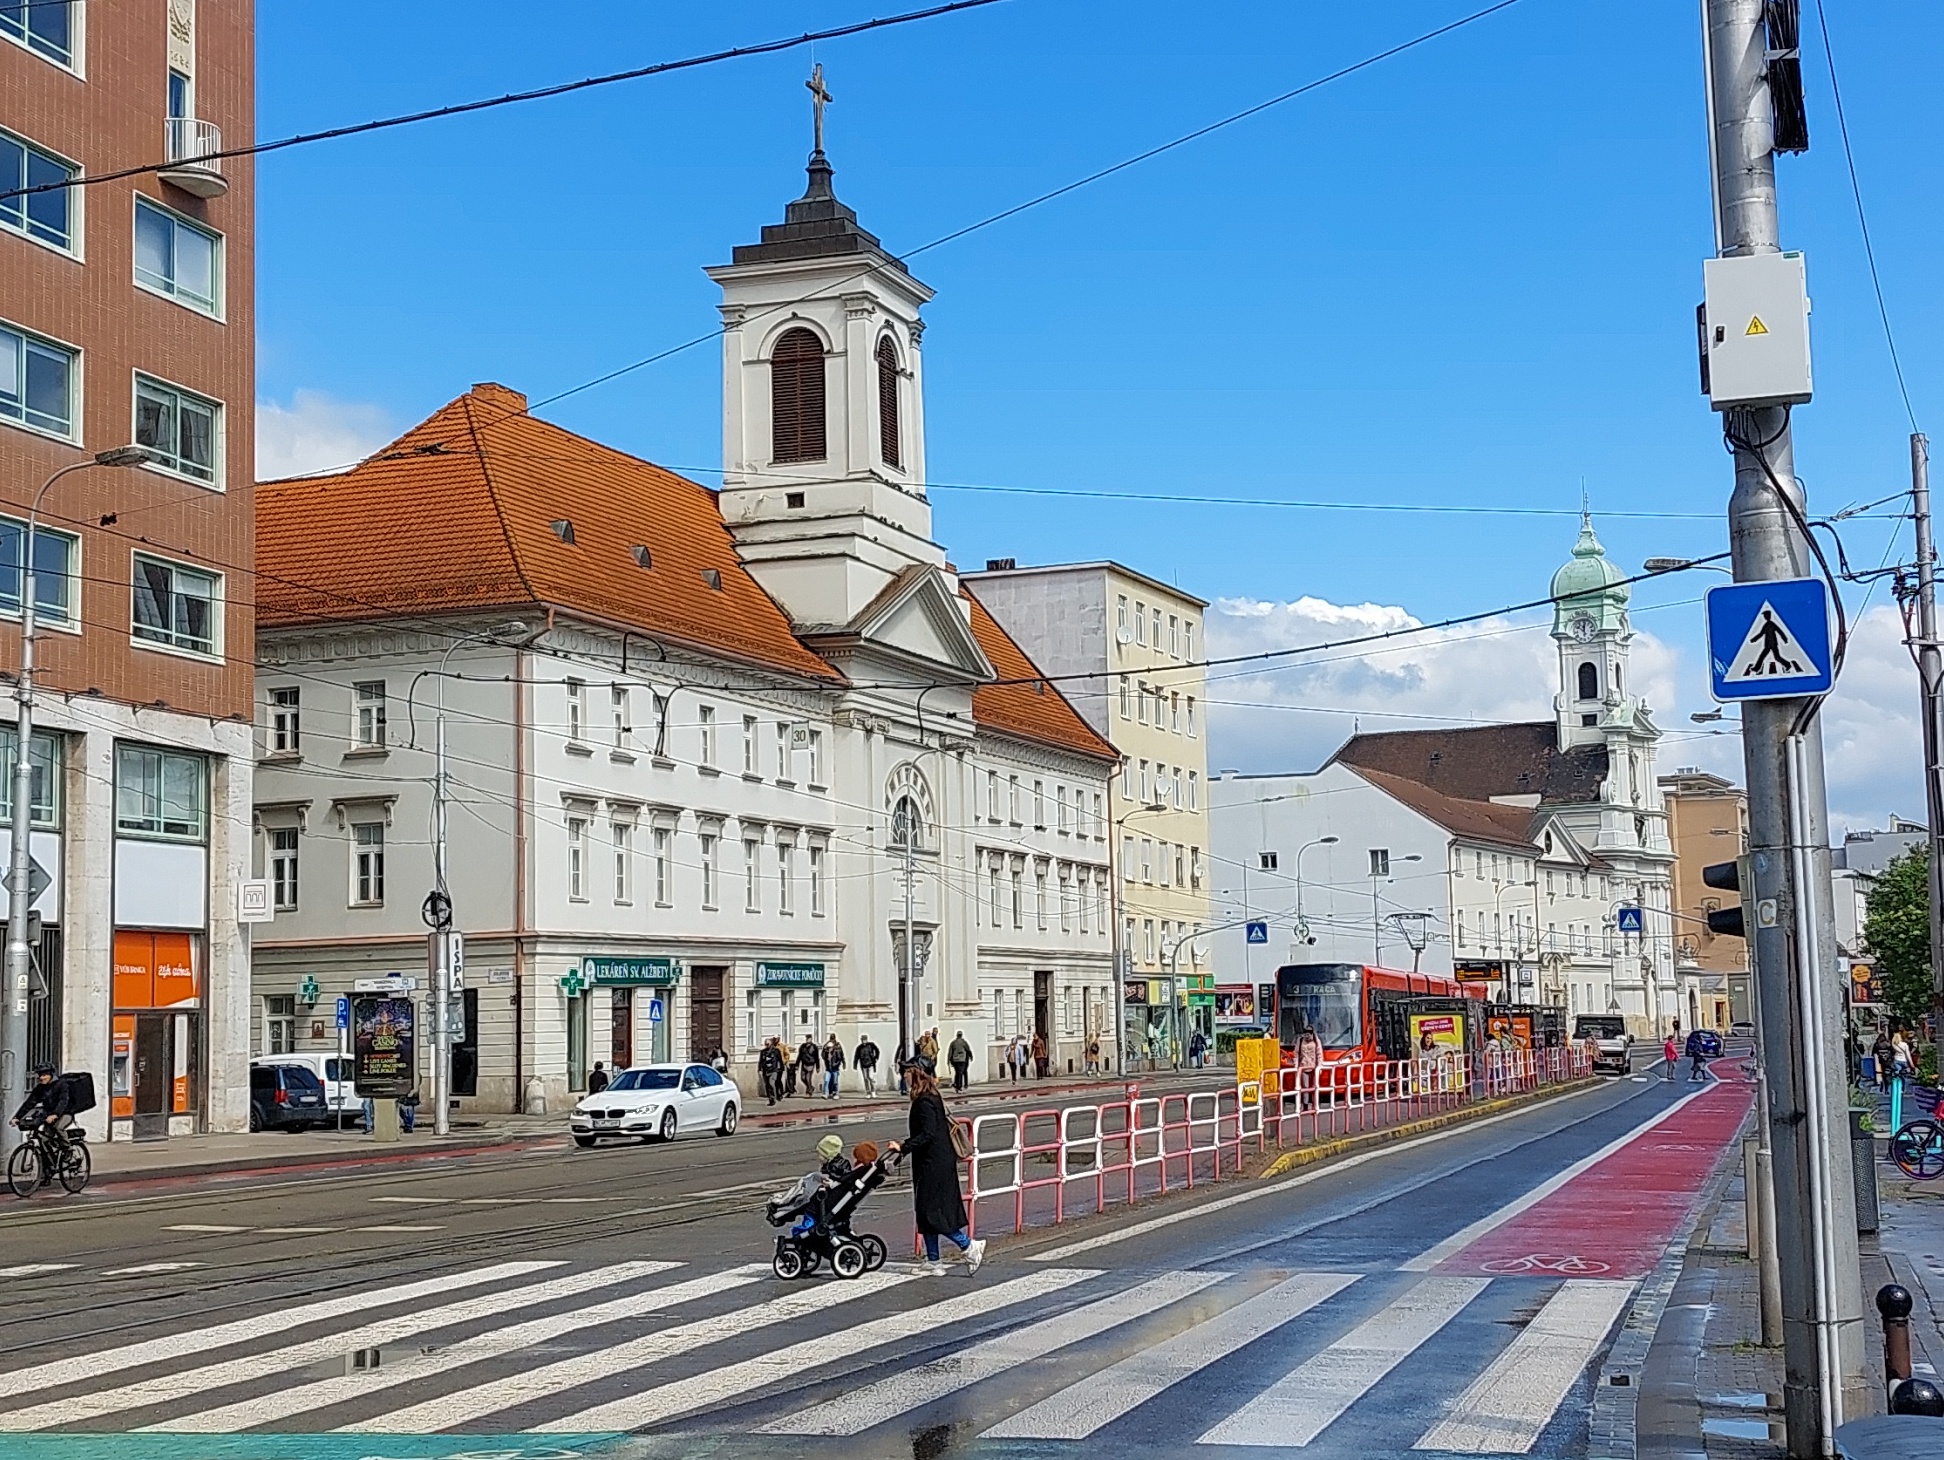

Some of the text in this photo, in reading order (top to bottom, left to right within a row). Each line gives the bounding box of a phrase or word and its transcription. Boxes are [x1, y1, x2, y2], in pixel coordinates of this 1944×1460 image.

[793, 729, 806, 742] 30
[1760, 901, 1775, 925] C
[597, 961, 629, 978] LEKÁREŇ
[641, 963, 669, 978] ALŽBETY
[1293, 985, 1299, 993] 3
[338, 1000, 345, 1016] P
